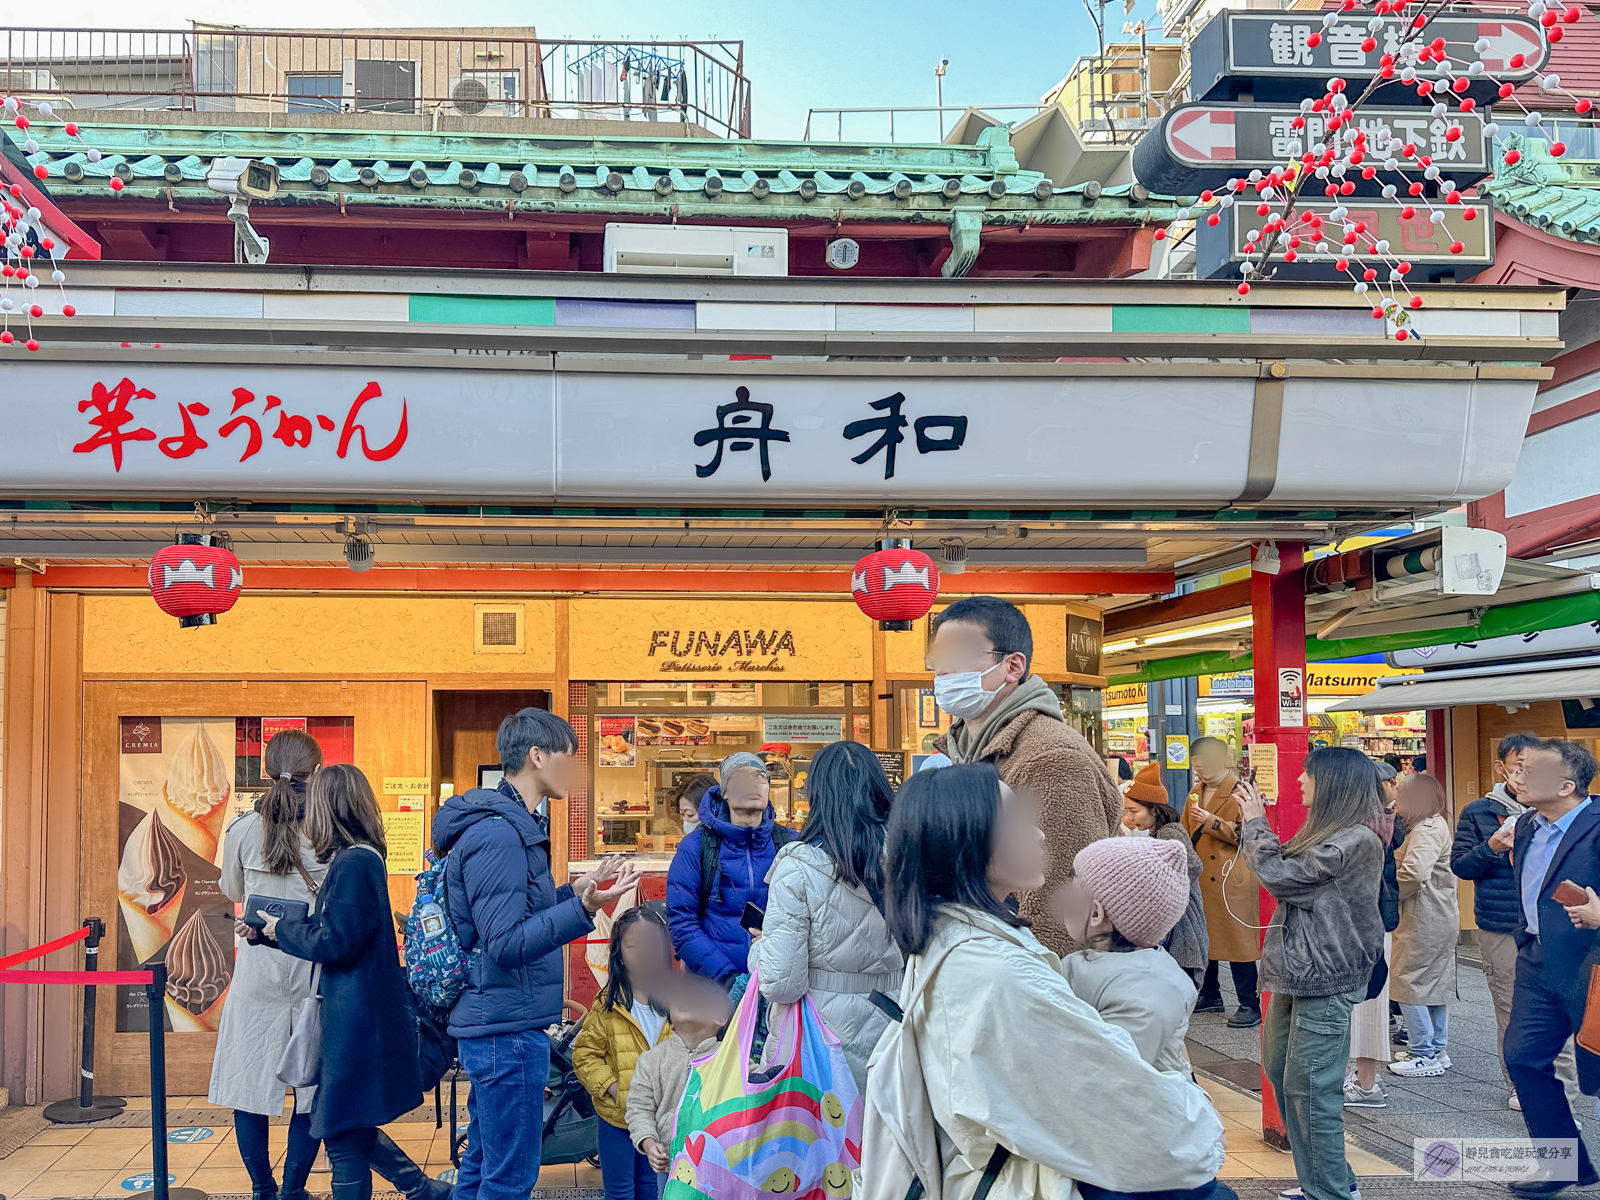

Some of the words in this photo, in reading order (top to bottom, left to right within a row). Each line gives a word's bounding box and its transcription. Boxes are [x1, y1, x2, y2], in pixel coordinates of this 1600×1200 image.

[693, 385, 969, 482] 舟和
[647, 629, 796, 658] FUNAWA
[1100, 686, 1136, 701] atsumoto
